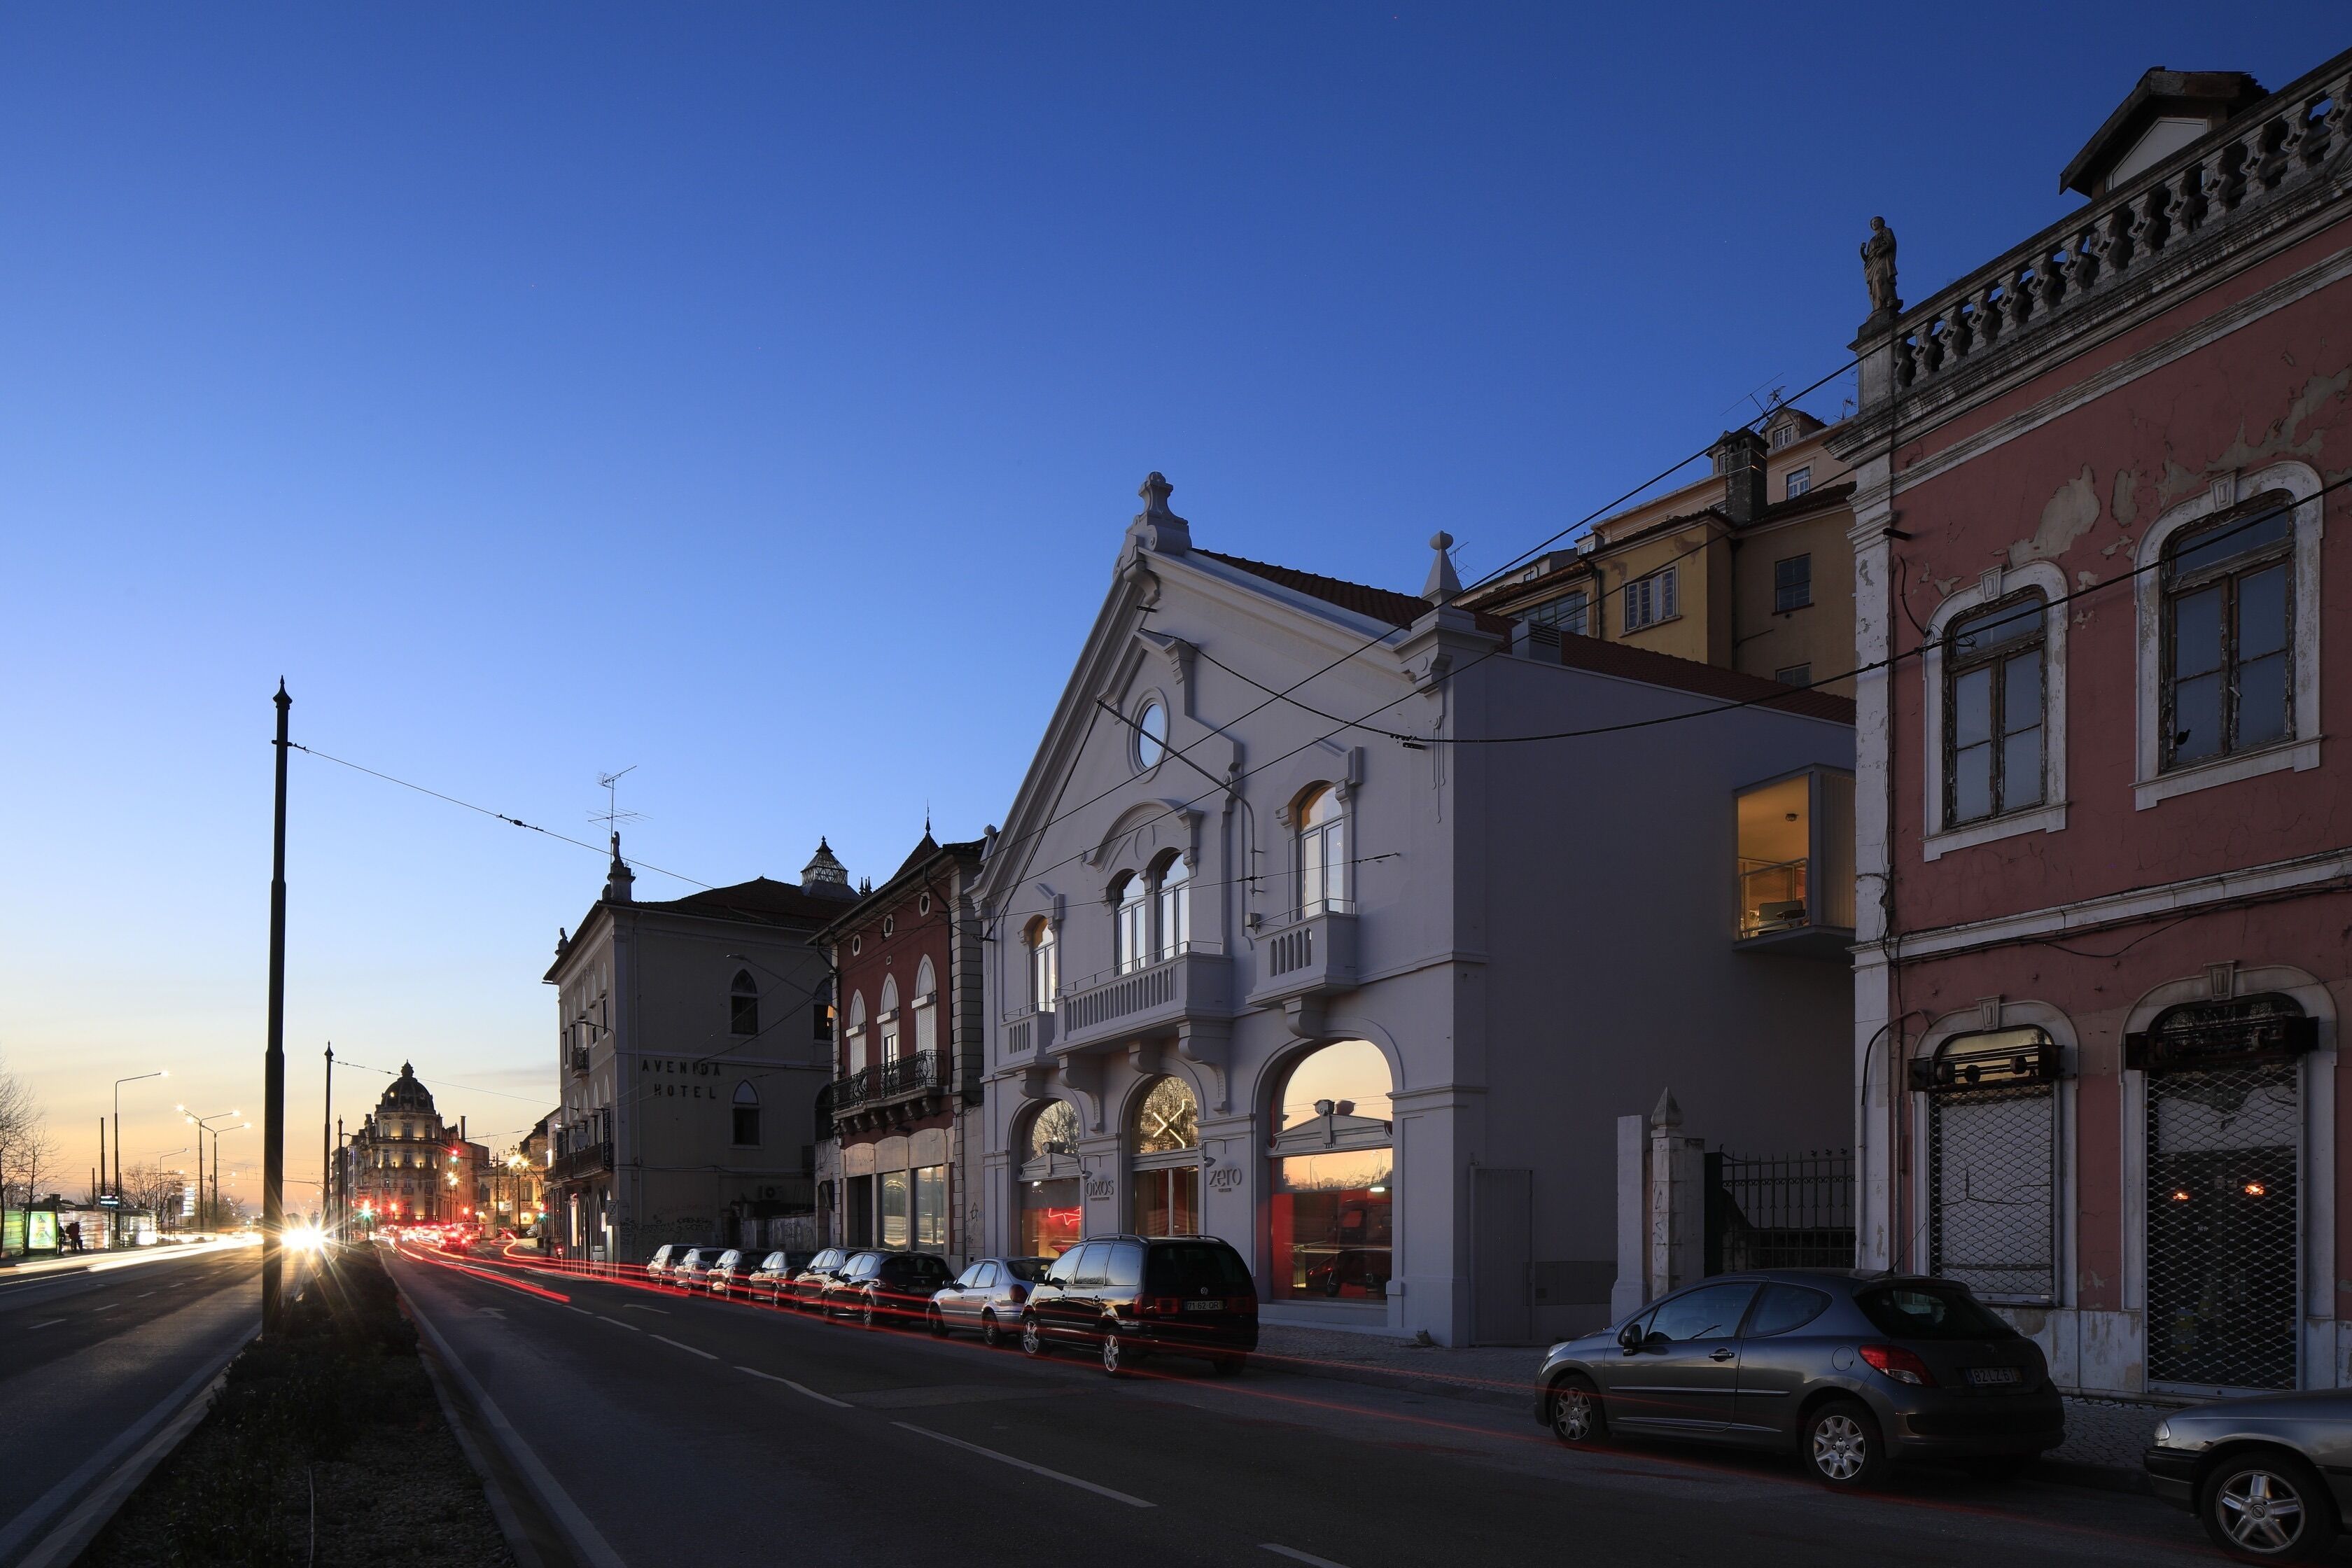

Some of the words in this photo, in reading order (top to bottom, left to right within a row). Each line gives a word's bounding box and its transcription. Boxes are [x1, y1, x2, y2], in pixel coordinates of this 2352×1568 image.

[642, 1059, 720, 1076] AVENIDA
[654, 1084, 716, 1099] HOTEL
[1209, 1168, 1242, 1187] zero
